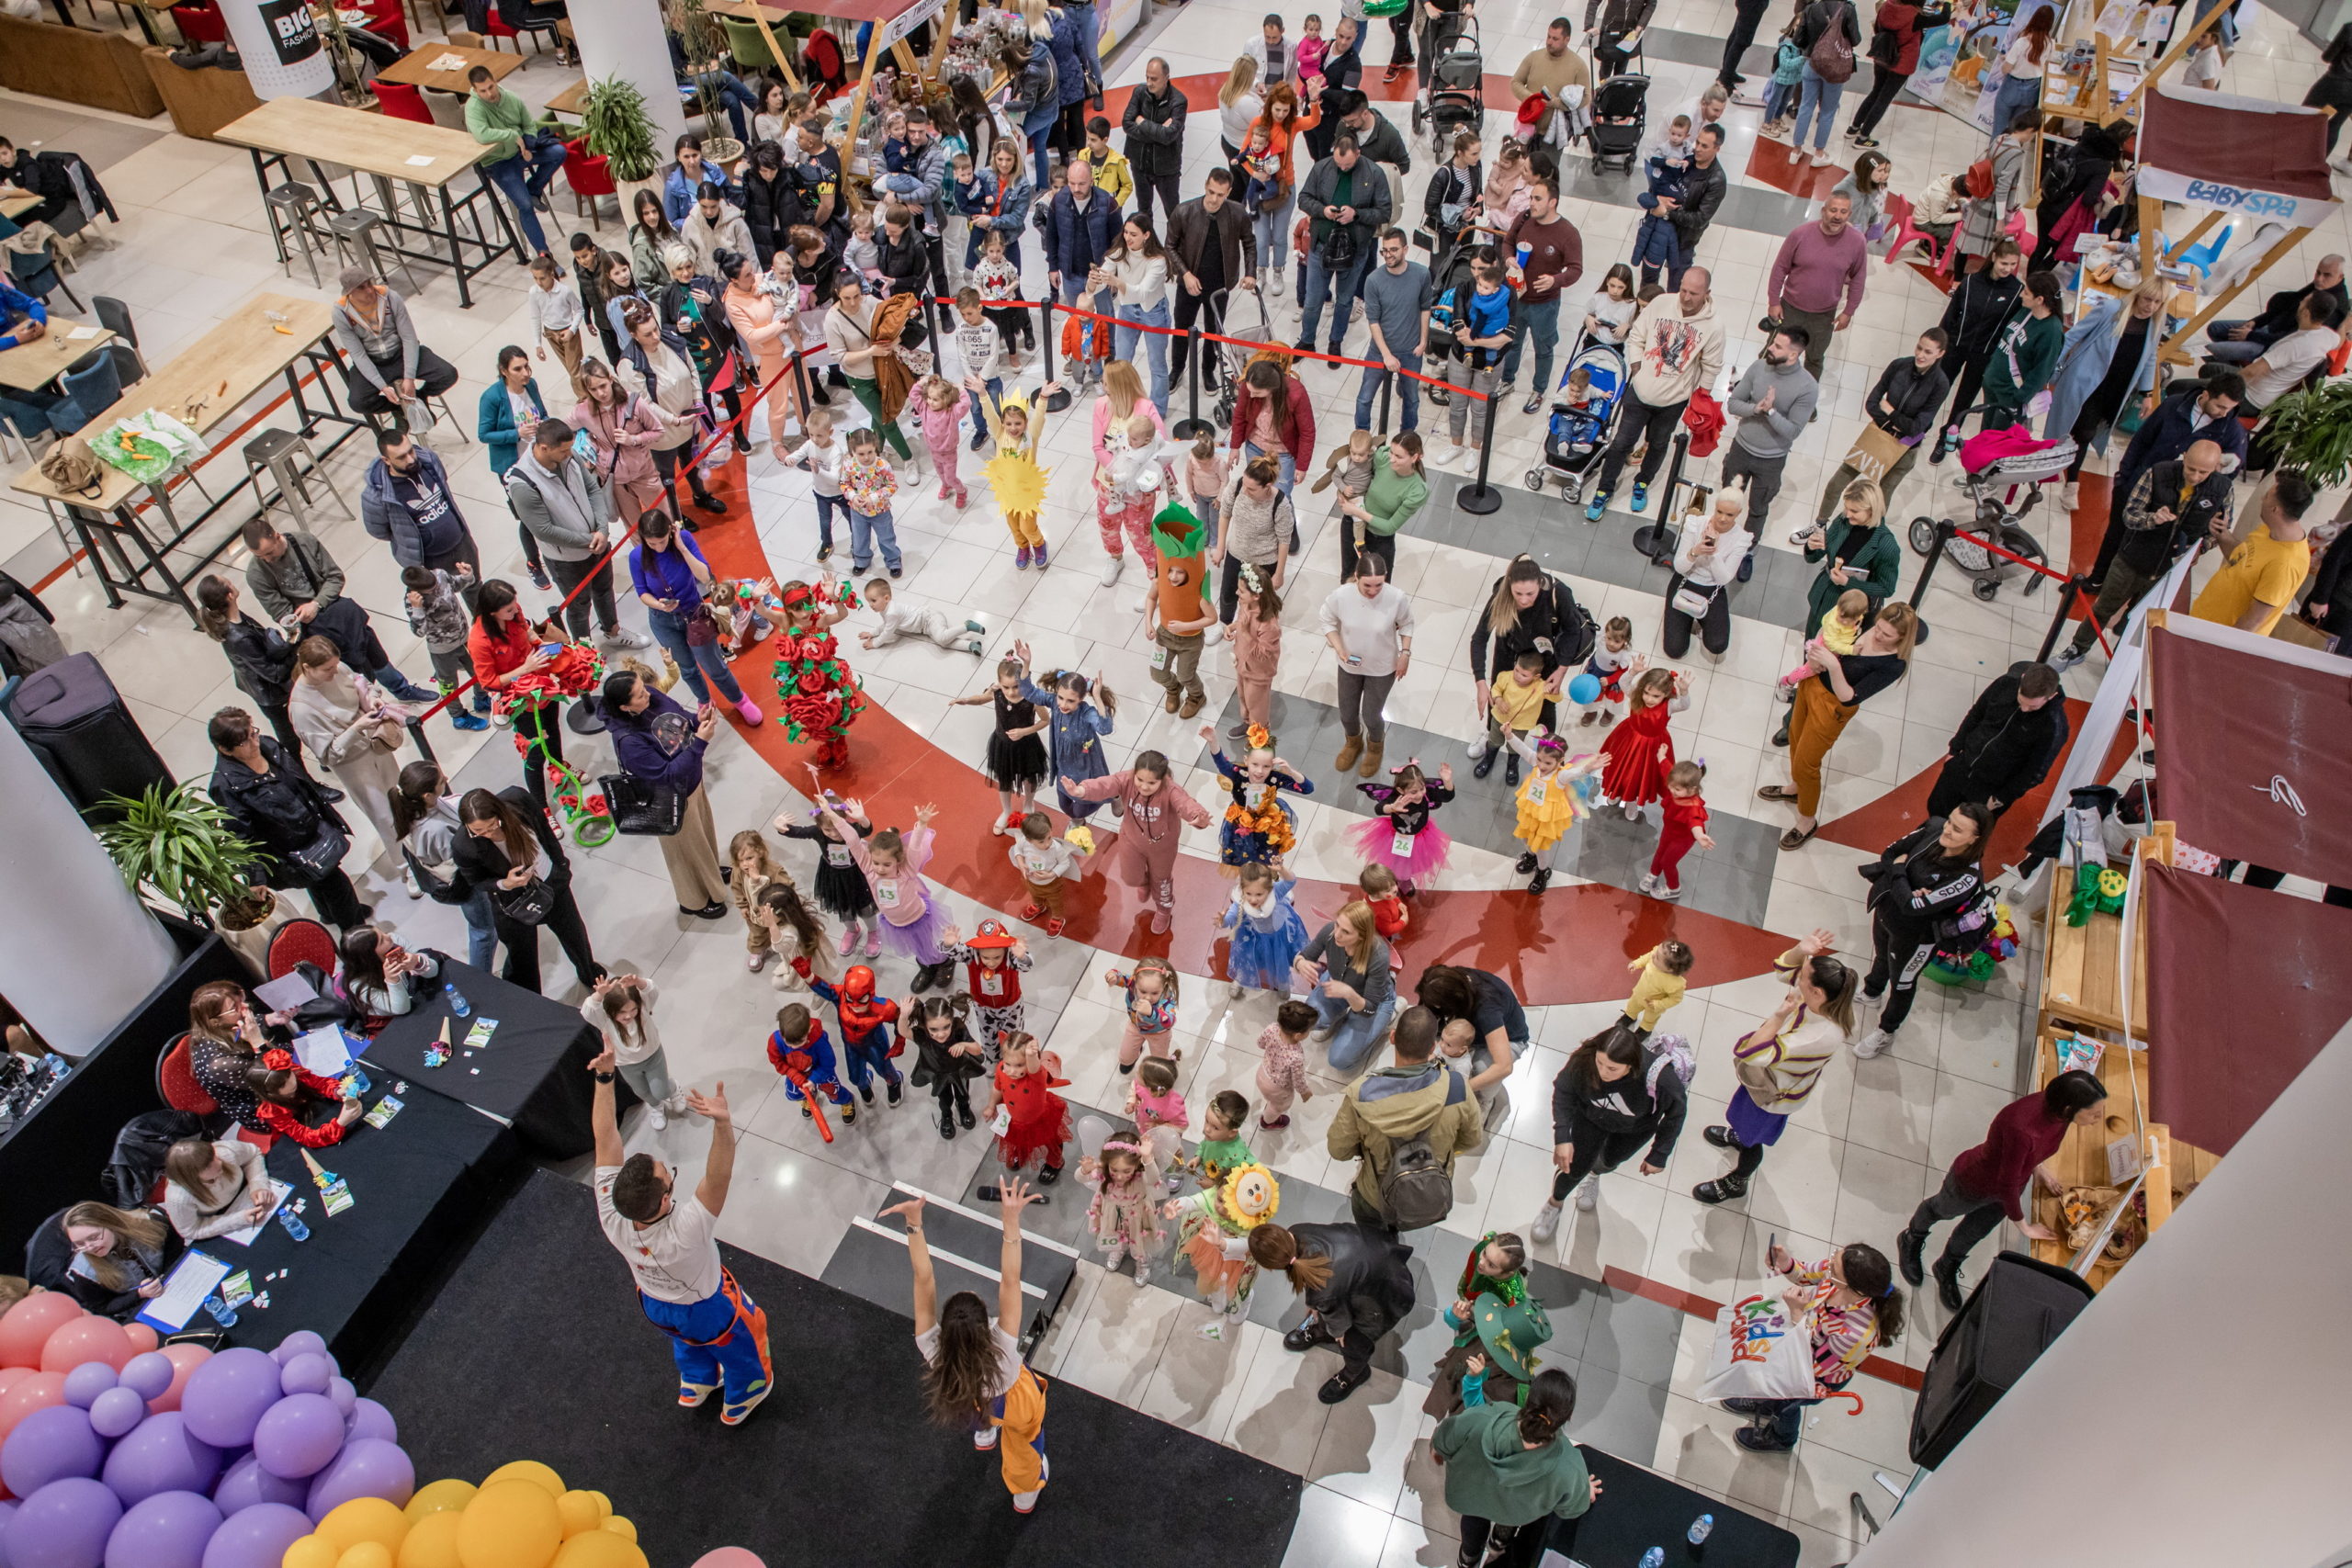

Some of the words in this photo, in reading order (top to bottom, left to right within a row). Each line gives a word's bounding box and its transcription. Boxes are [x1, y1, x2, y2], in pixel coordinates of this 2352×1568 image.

[274, 6, 311, 39] BIG
[282, 28, 316, 49] FASHION
[419, 501, 448, 525] adida
[1153, 652, 1164, 662] 32
[1532, 786, 1544, 800] 21
[1253, 794, 1259, 805] 1
[1395, 840, 1408, 852] 26
[831, 852, 847, 862] 14
[1939, 874, 1974, 897] didas
[878, 888, 896, 900] 13
[987, 982, 996, 992] 5
[1000, 1114, 1007, 1127] 3
[1102, 1237, 1118, 1246] 10
[1745, 1299, 1785, 1355] Kids
